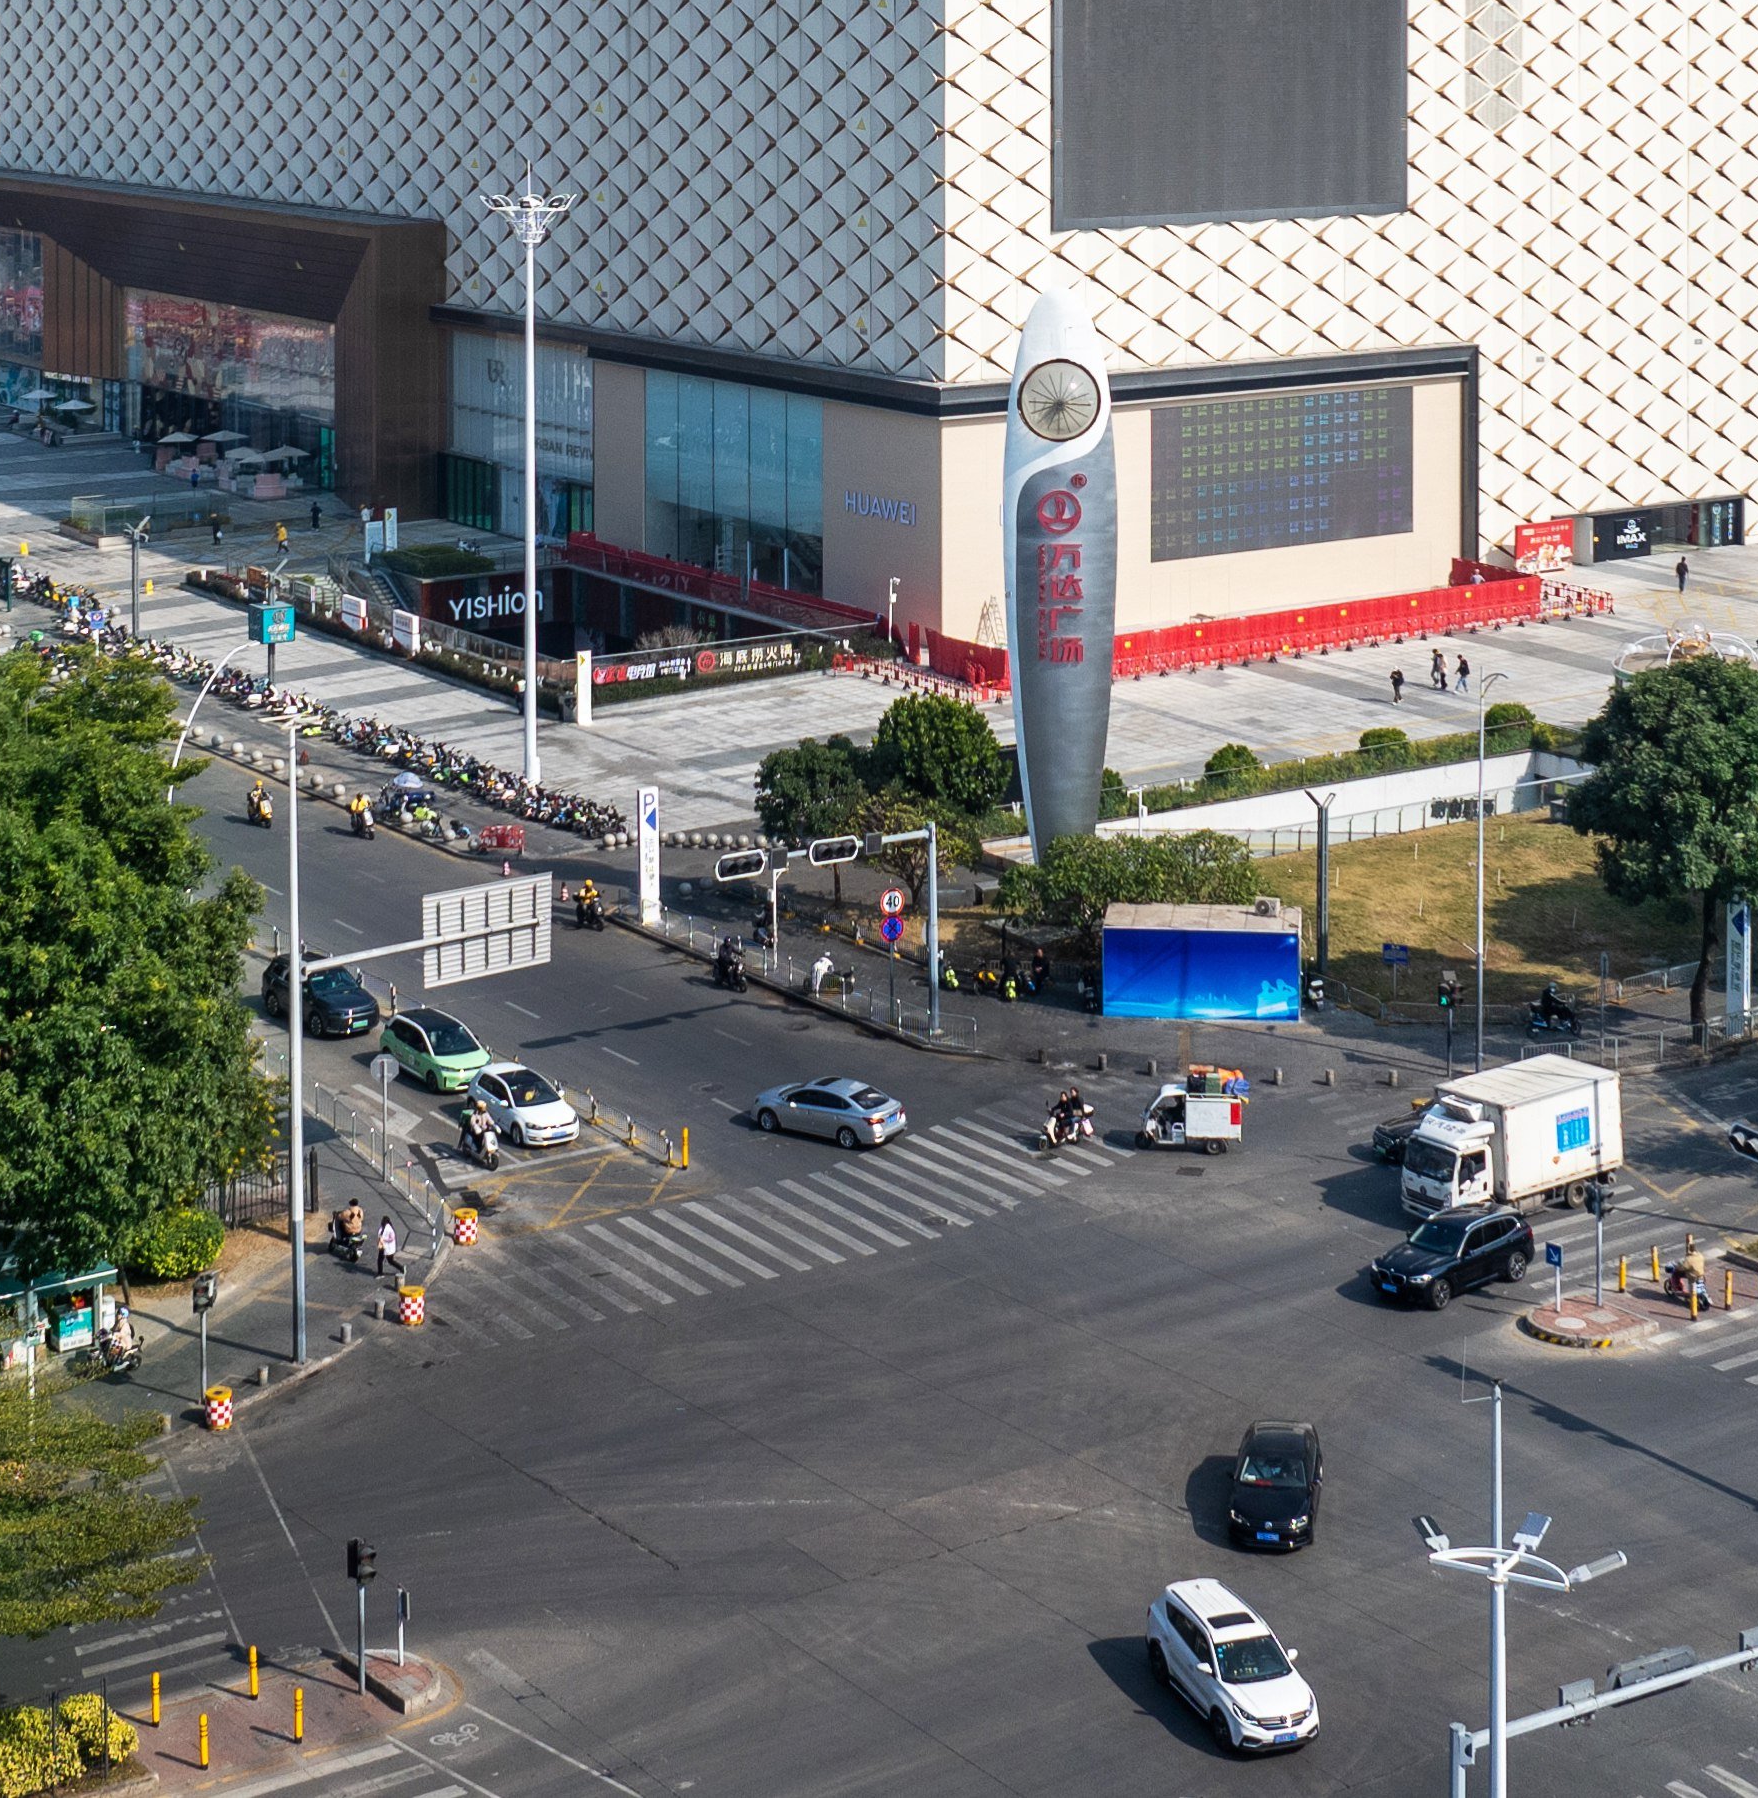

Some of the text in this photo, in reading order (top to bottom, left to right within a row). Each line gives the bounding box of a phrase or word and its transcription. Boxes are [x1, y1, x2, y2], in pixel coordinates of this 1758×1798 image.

[534, 436, 563, 455] RBAN
[845, 490, 916, 526] HUAWEI
[1049, 543, 1084, 663] 万达广场
[643, 792, 655, 815] P
[885, 895, 900, 908] 40
